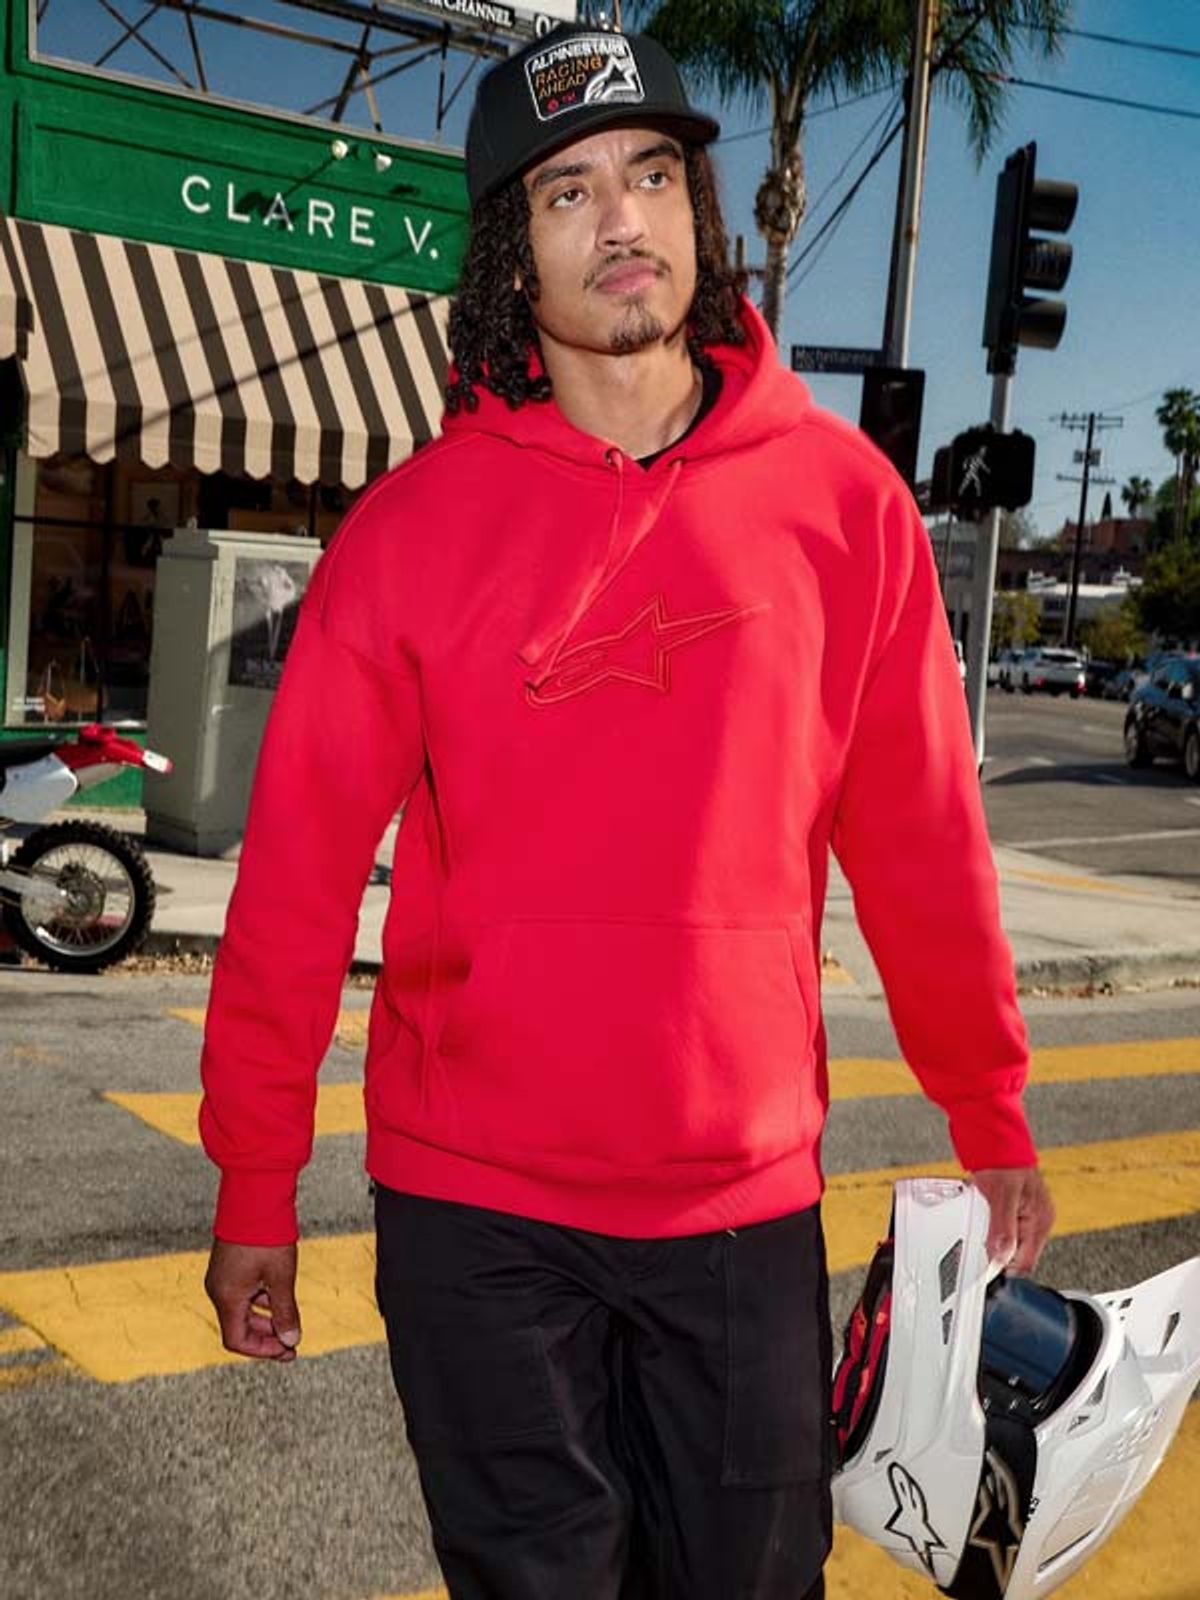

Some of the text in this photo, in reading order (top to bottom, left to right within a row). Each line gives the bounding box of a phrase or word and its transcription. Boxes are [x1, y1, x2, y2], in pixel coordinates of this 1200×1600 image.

[535, 56, 603, 90] RACING
[539, 73, 586, 99] AHEAD
[181, 175, 439, 260] CLARE V.
